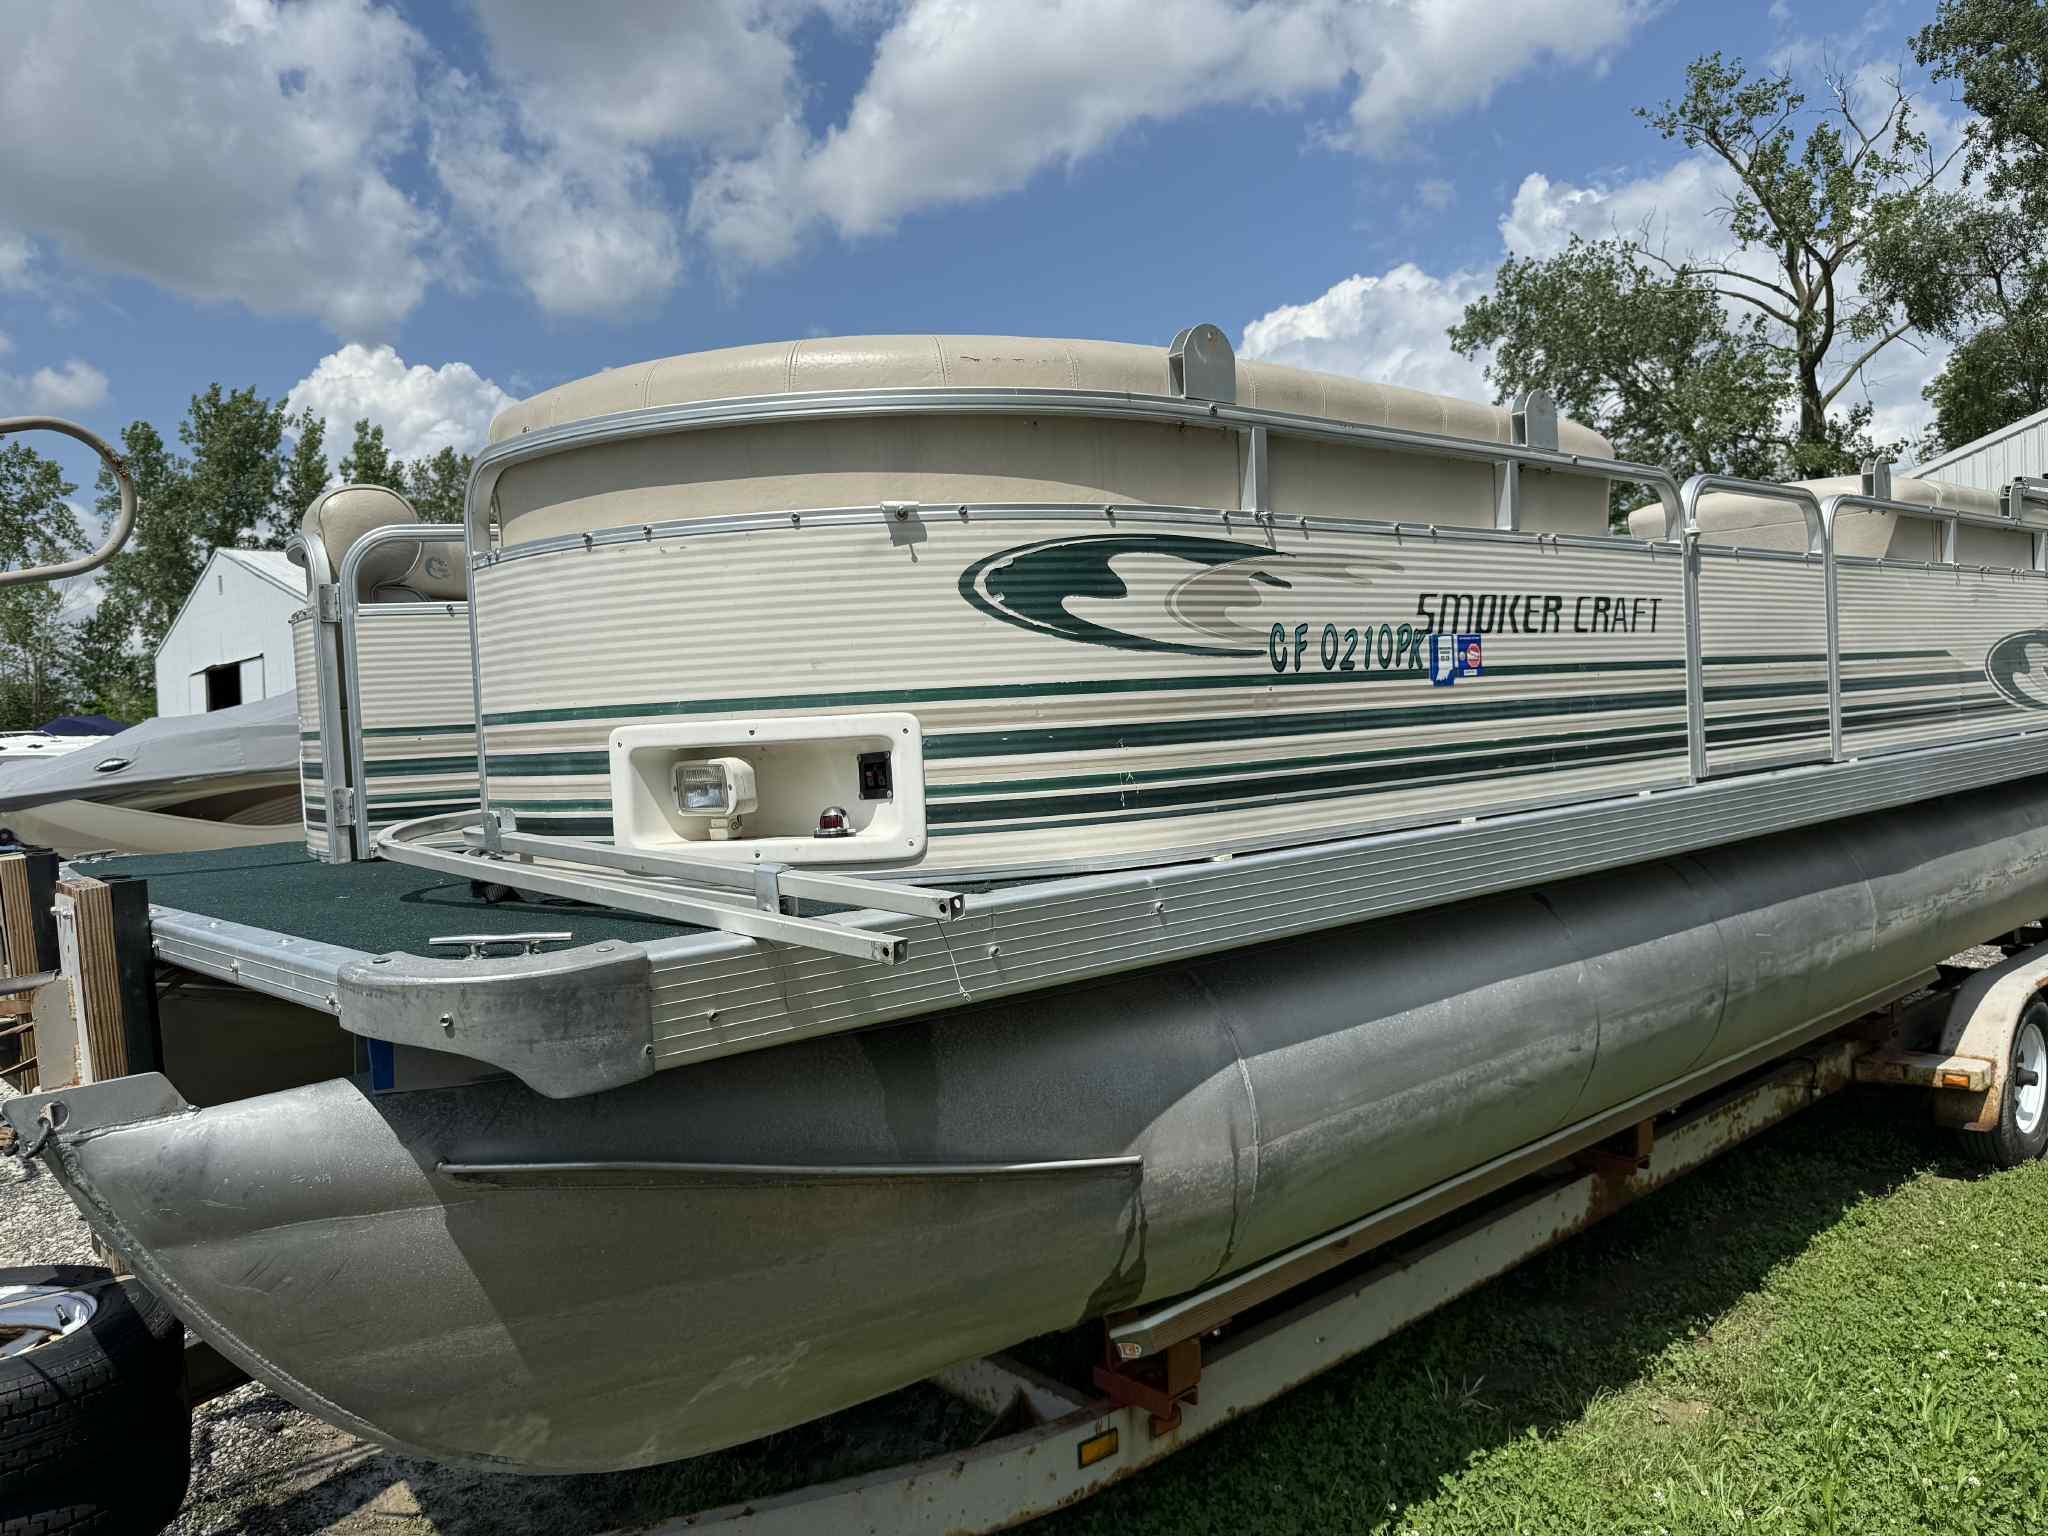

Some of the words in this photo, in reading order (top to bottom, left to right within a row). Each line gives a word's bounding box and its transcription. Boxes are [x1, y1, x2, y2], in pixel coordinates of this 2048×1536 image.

[1416, 593, 1563, 634] SMOKER
[1573, 596, 1663, 633] CRAFT
[1269, 622, 1309, 673] CF
